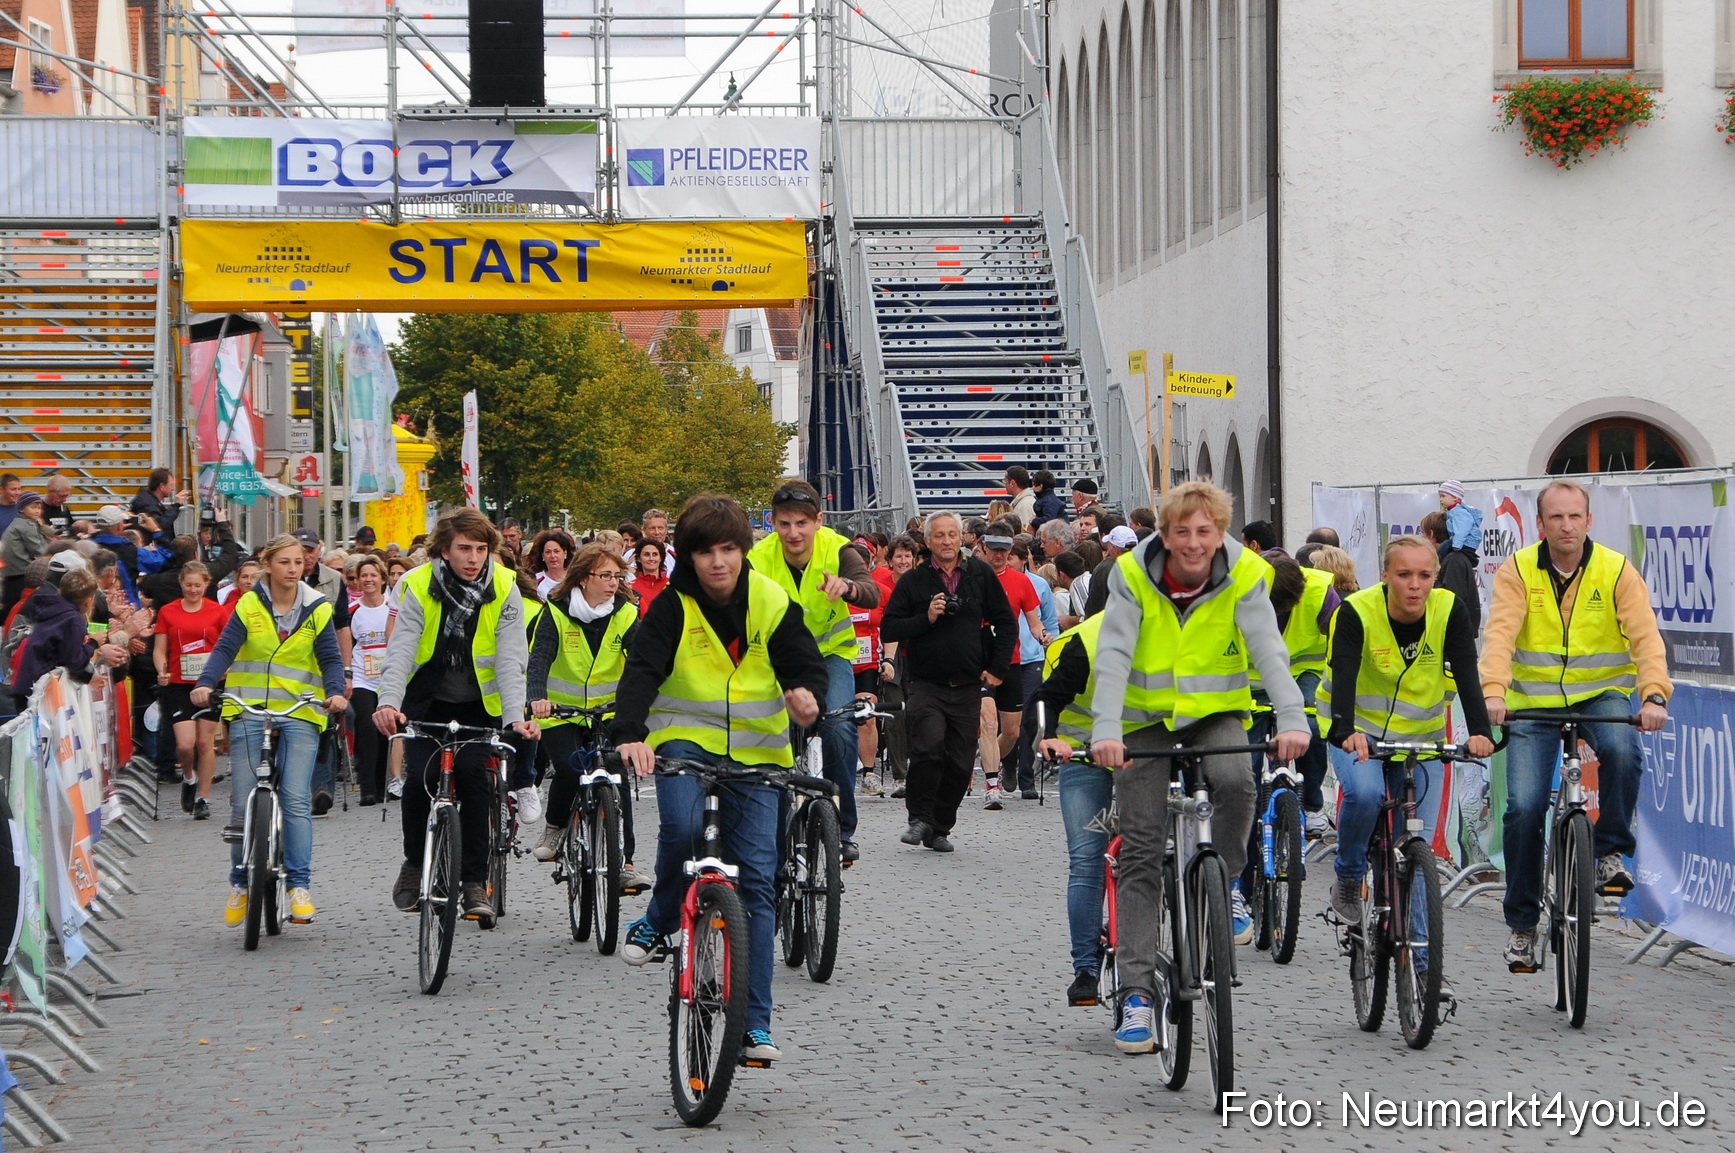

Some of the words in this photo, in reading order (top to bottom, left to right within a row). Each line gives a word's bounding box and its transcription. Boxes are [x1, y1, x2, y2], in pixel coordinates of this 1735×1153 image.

[278, 139, 515, 187] BOCK
[669, 148, 809, 172] PFLEIDERER
[669, 175, 810, 187] AKTIENGESELLSCHAFT
[390, 190, 514, 204] www.bockonline.de
[216, 262, 290, 275] Neumarkter
[292, 261, 350, 274] Stadtlauf
[388, 238, 600, 284] START
[639, 264, 711, 276] Neumarkter
[714, 263, 772, 276] Stadtlauf
[1178, 373, 1216, 384] Kinder-
[1170, 384, 1222, 397] betreuung
[216, 468, 260, 480] vice-Lin
[1643, 525, 1716, 624] BOCK
